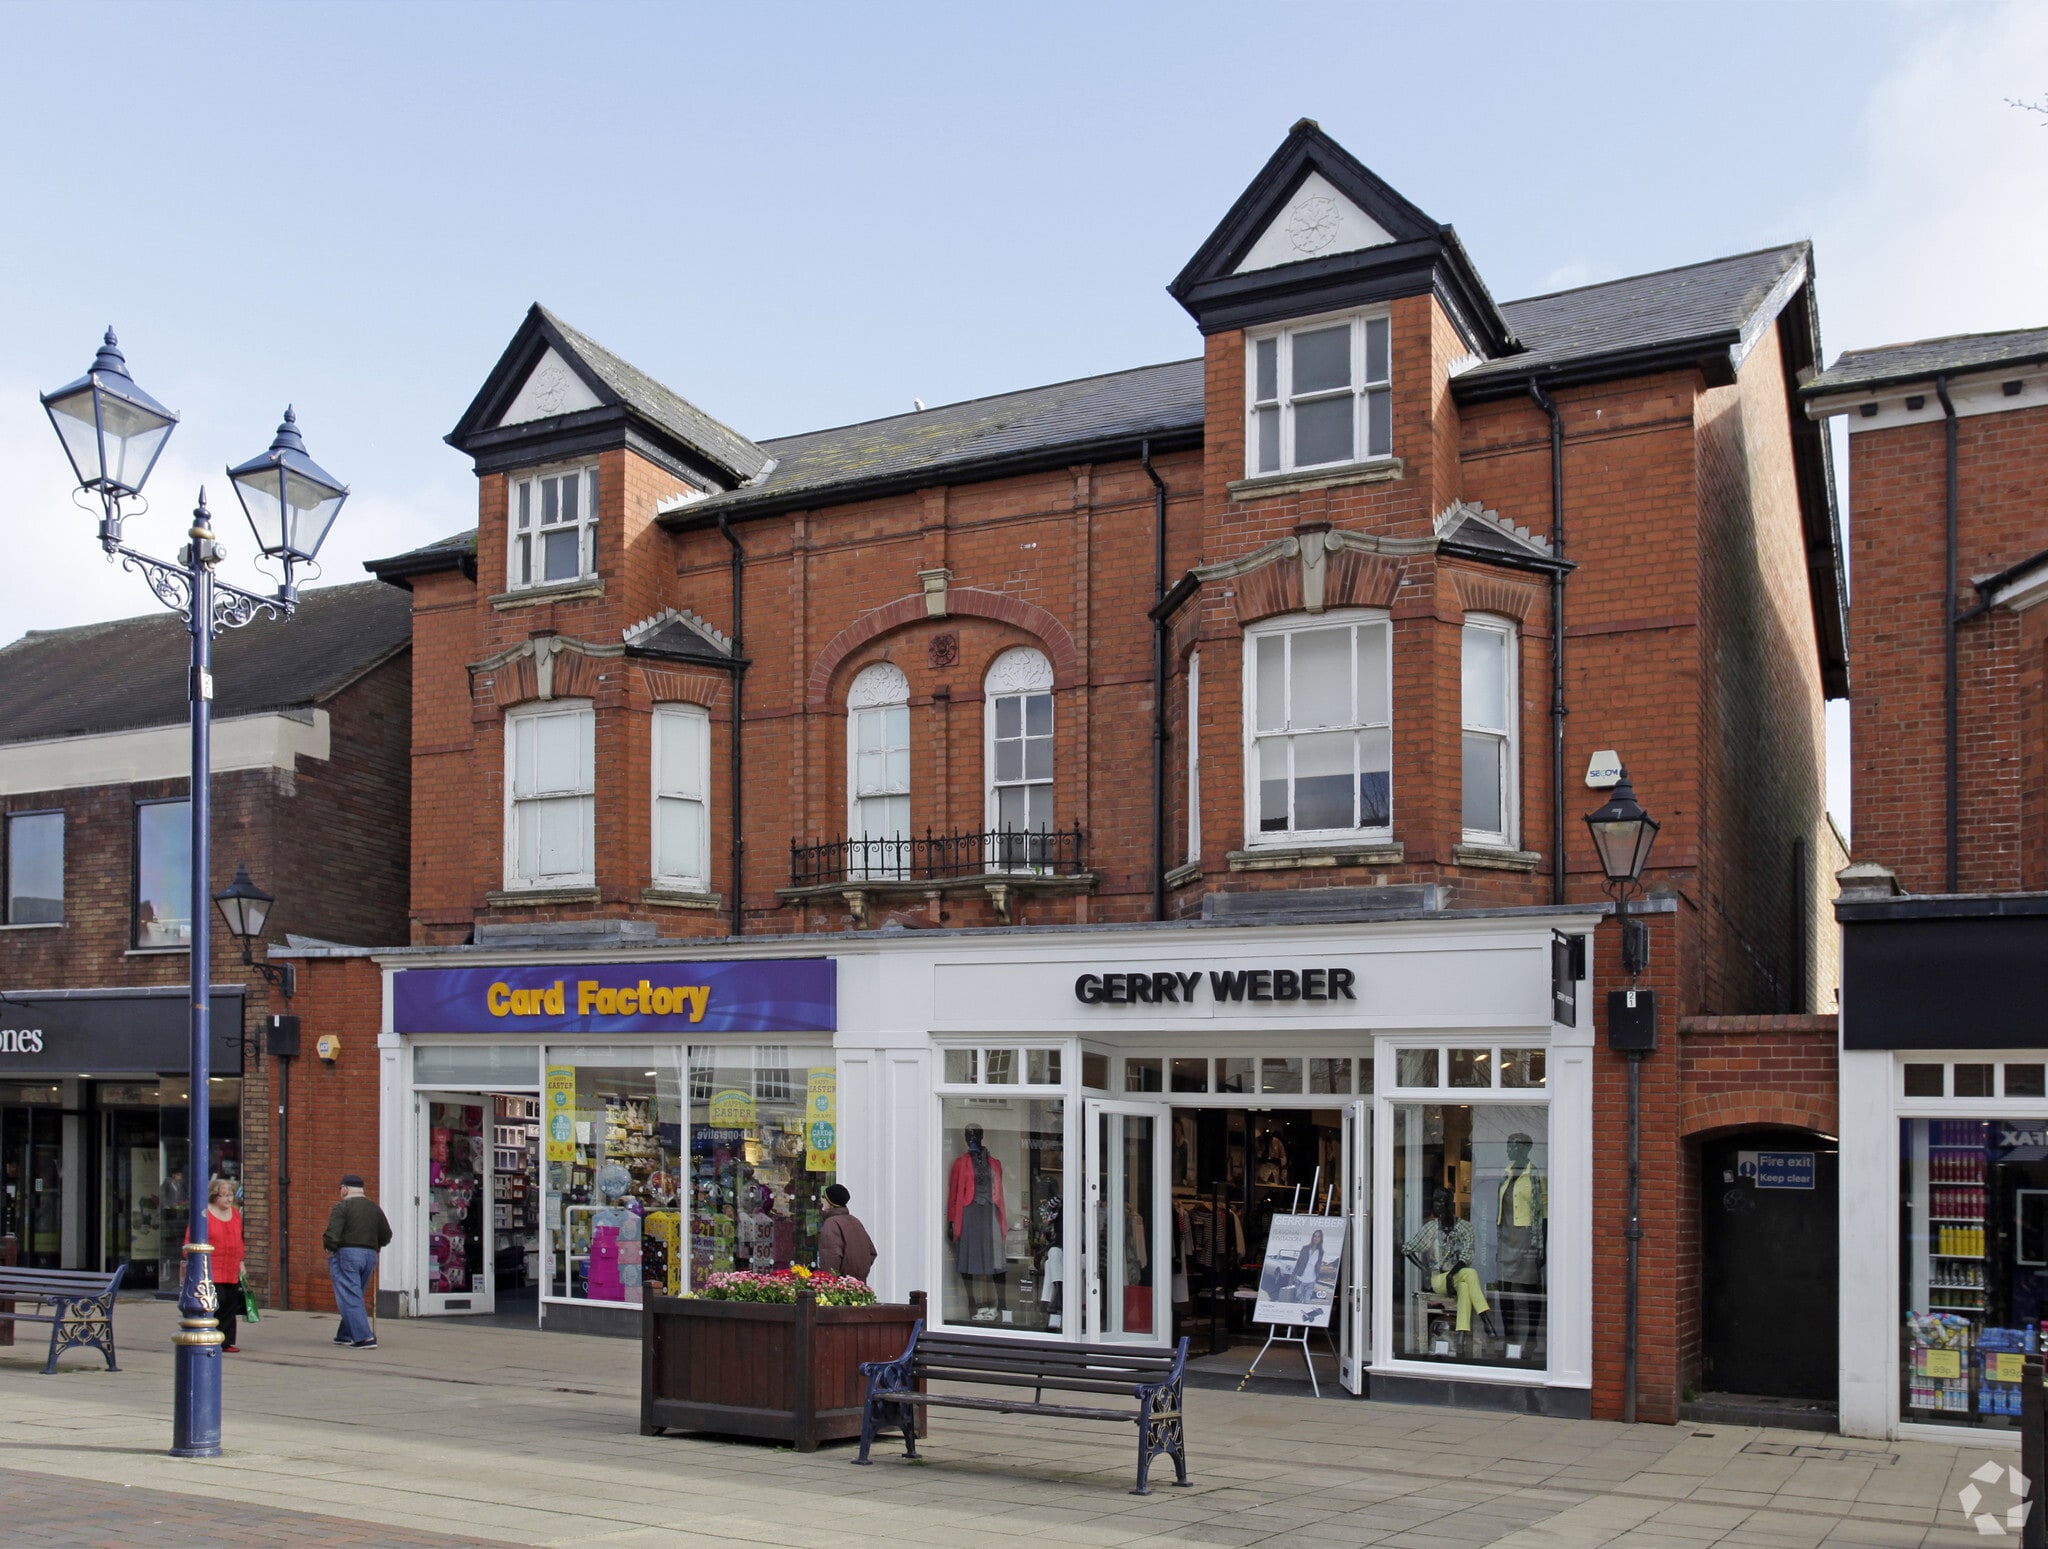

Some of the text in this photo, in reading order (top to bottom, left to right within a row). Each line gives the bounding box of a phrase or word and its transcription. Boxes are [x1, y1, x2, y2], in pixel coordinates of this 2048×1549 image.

[1590, 769, 1618, 777] SECOM
[1075, 967, 1358, 1004] GERRY WEBER
[487, 979, 711, 1023] Card Factory
[0, 1029, 43, 1053] nes
[714, 1107, 752, 1118] EASTER
[1760, 1156, 1811, 1167] Fire exit
[1760, 1173, 1811, 1183] Keep clear
[1274, 1216, 1345, 1228] GERRY WEBER
[699, 1221, 710, 1237] 21
[757, 1224, 771, 1239] 50
[756, 1245, 771, 1259] 50
[1933, 1365, 1951, 1375] 99p
